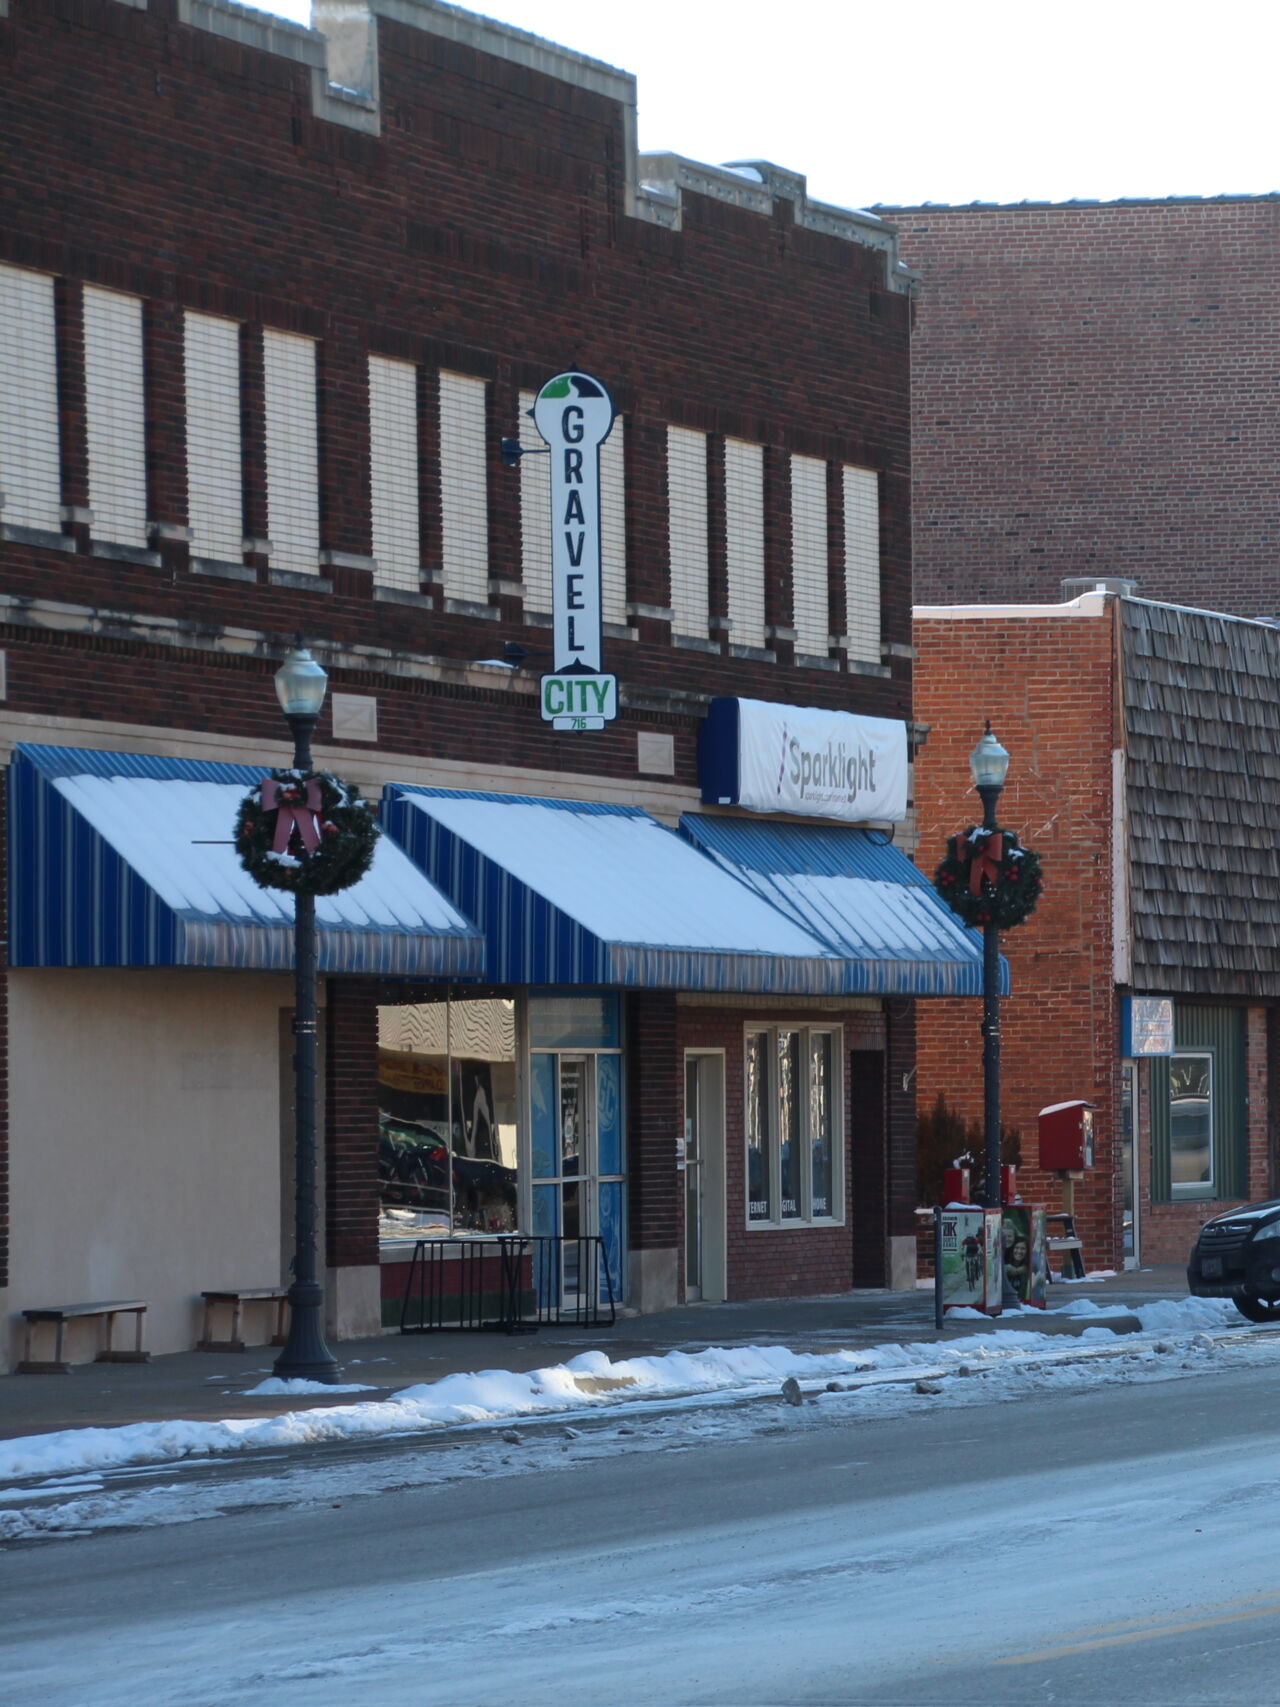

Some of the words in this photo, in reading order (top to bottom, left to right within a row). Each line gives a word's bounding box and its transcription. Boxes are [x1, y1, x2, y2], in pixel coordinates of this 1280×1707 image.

[561, 405, 585, 651] GRAVEL
[544, 679, 611, 715] CITY
[571, 717, 587, 729] 716
[789, 736, 876, 803] Sparklight
[781, 1199, 797, 1212] GITAL
[812, 1197, 827, 1210] HONE
